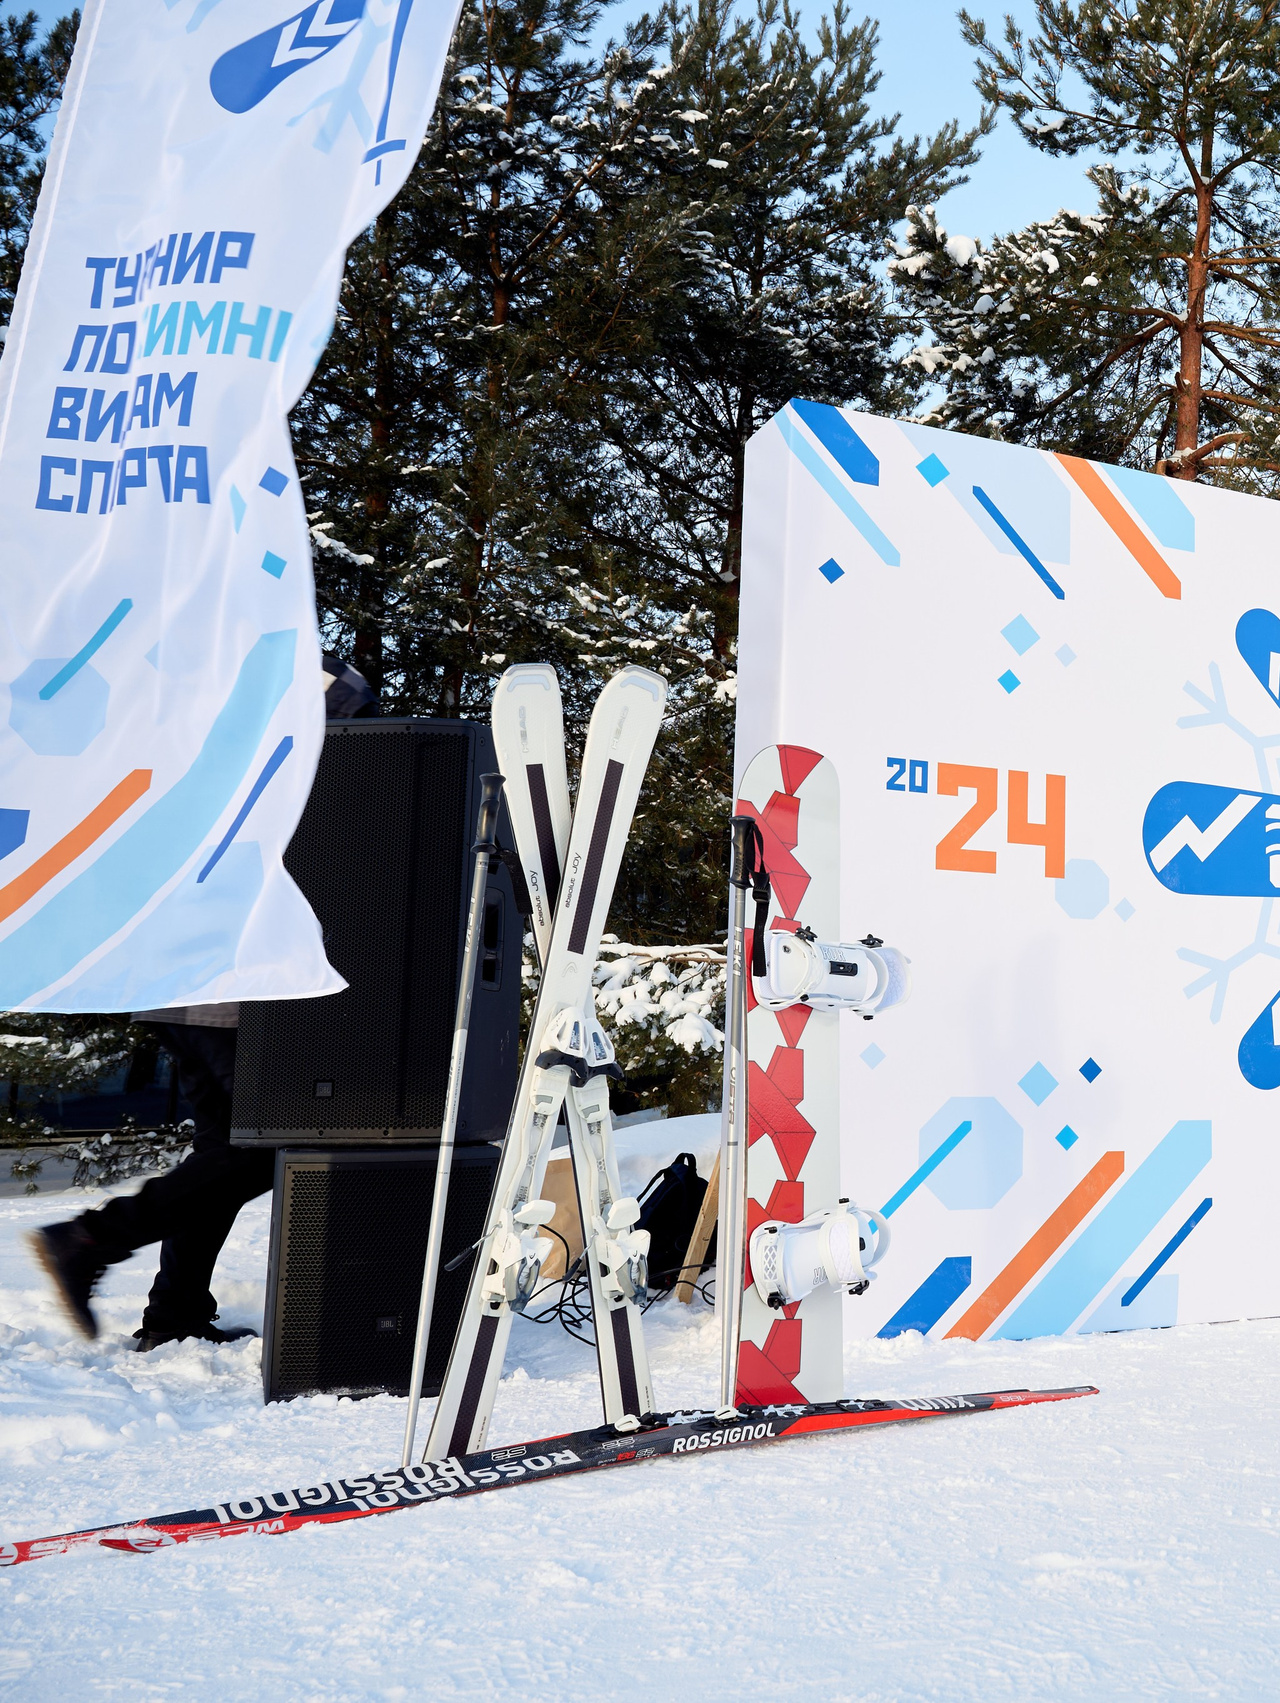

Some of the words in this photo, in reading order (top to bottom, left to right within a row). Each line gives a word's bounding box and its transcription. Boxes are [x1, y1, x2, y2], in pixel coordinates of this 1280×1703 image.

[62, 321, 137, 375] ПО
[886, 757, 928, 793] 20
[935, 762, 1066, 879] 24
[529, 870, 538, 891] JOY
[572, 853, 582, 874] JOY
[733, 926, 743, 977] LEKI
[672, 1423, 776, 1453] ROSSIGNOL
[213, 1456, 470, 1524] ROSSIGNOL
[334, 1449, 581, 1511] ROSSIGNOL
